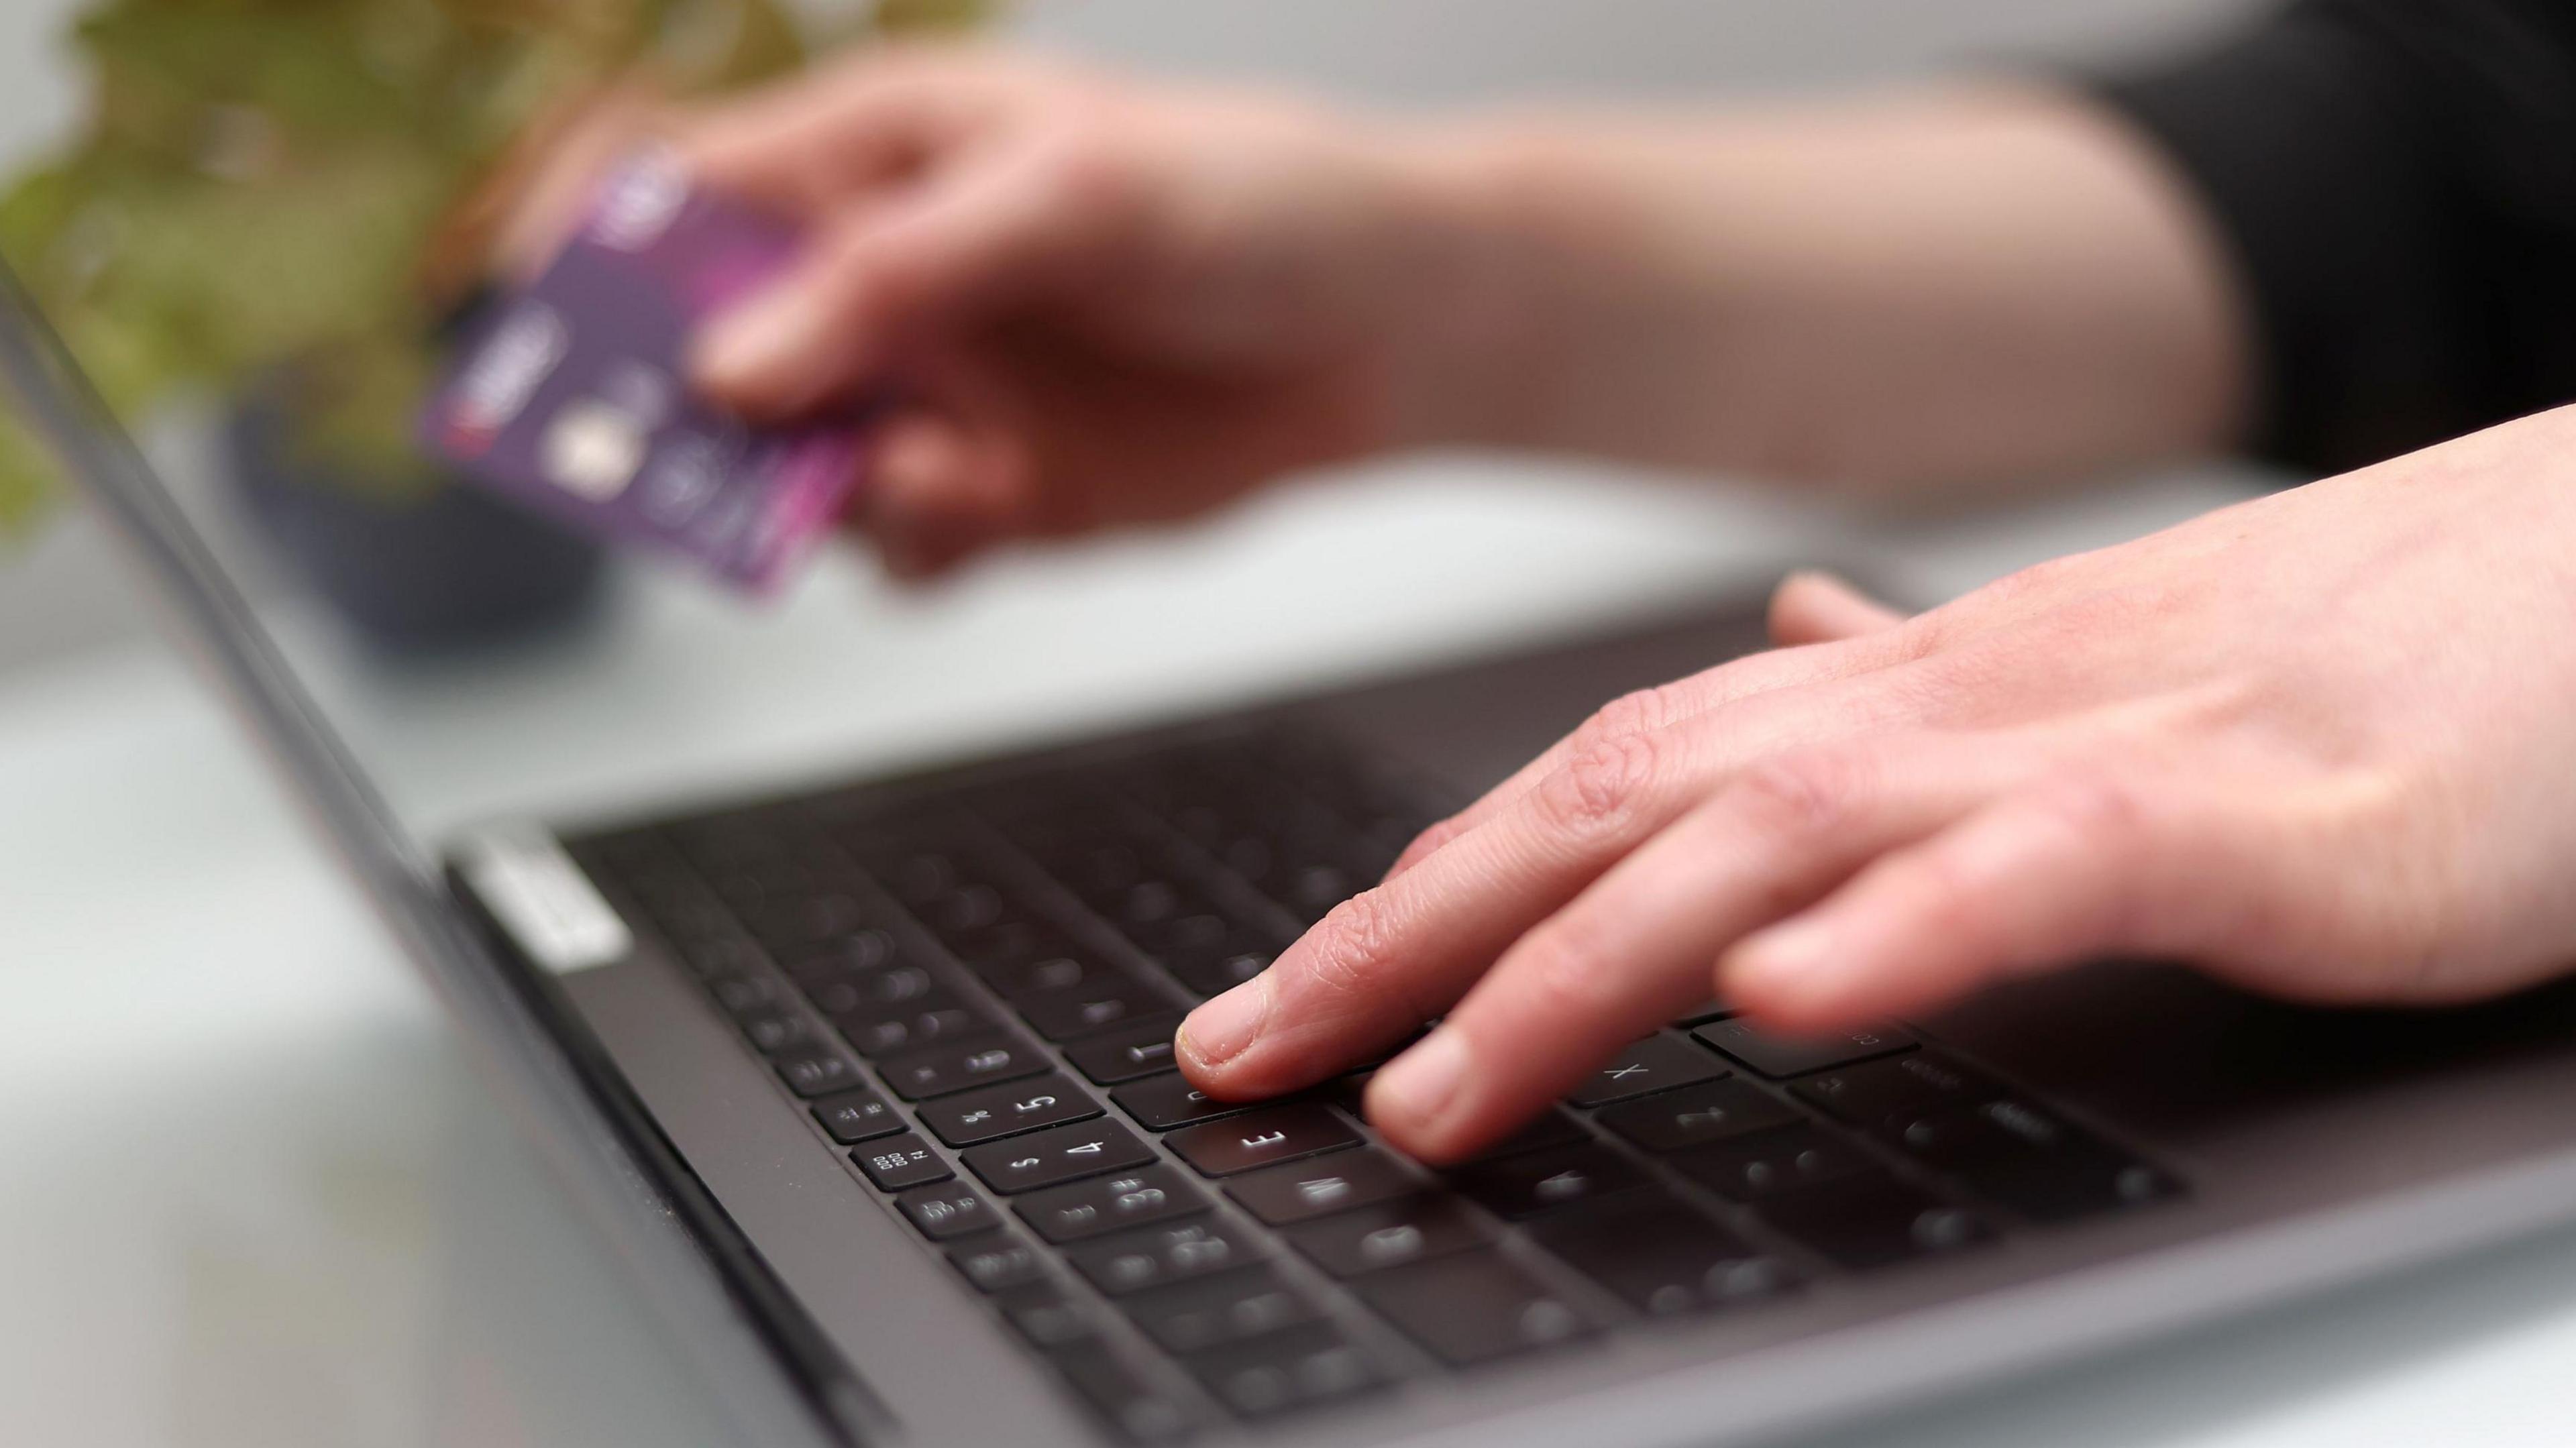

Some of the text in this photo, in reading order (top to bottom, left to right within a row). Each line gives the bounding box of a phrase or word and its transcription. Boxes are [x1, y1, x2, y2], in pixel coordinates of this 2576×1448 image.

[1604, 1064, 1648, 1078] X
[1014, 1096, 1056, 1111] 5
[961, 1110, 991, 1123] %
[1241, 1131, 1286, 1146] E
[1067, 1141, 1104, 1154] 4
[910, 1150, 928, 1160] F4
